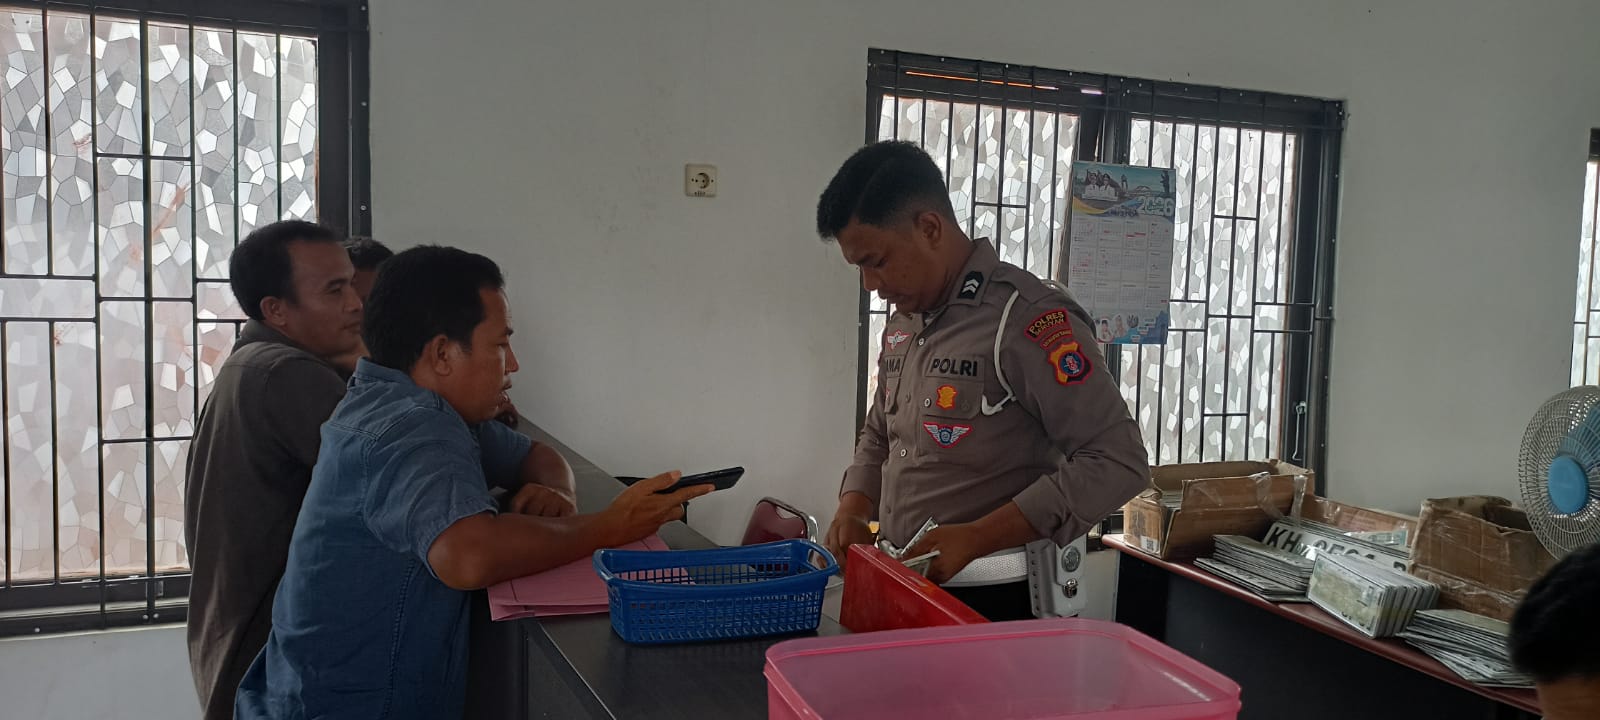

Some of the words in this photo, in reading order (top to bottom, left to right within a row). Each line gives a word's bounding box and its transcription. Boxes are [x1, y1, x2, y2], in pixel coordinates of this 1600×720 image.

[1028, 311, 1065, 334] POLRES
[929, 358, 978, 377] POLRI
[1266, 526, 1303, 553] KH
